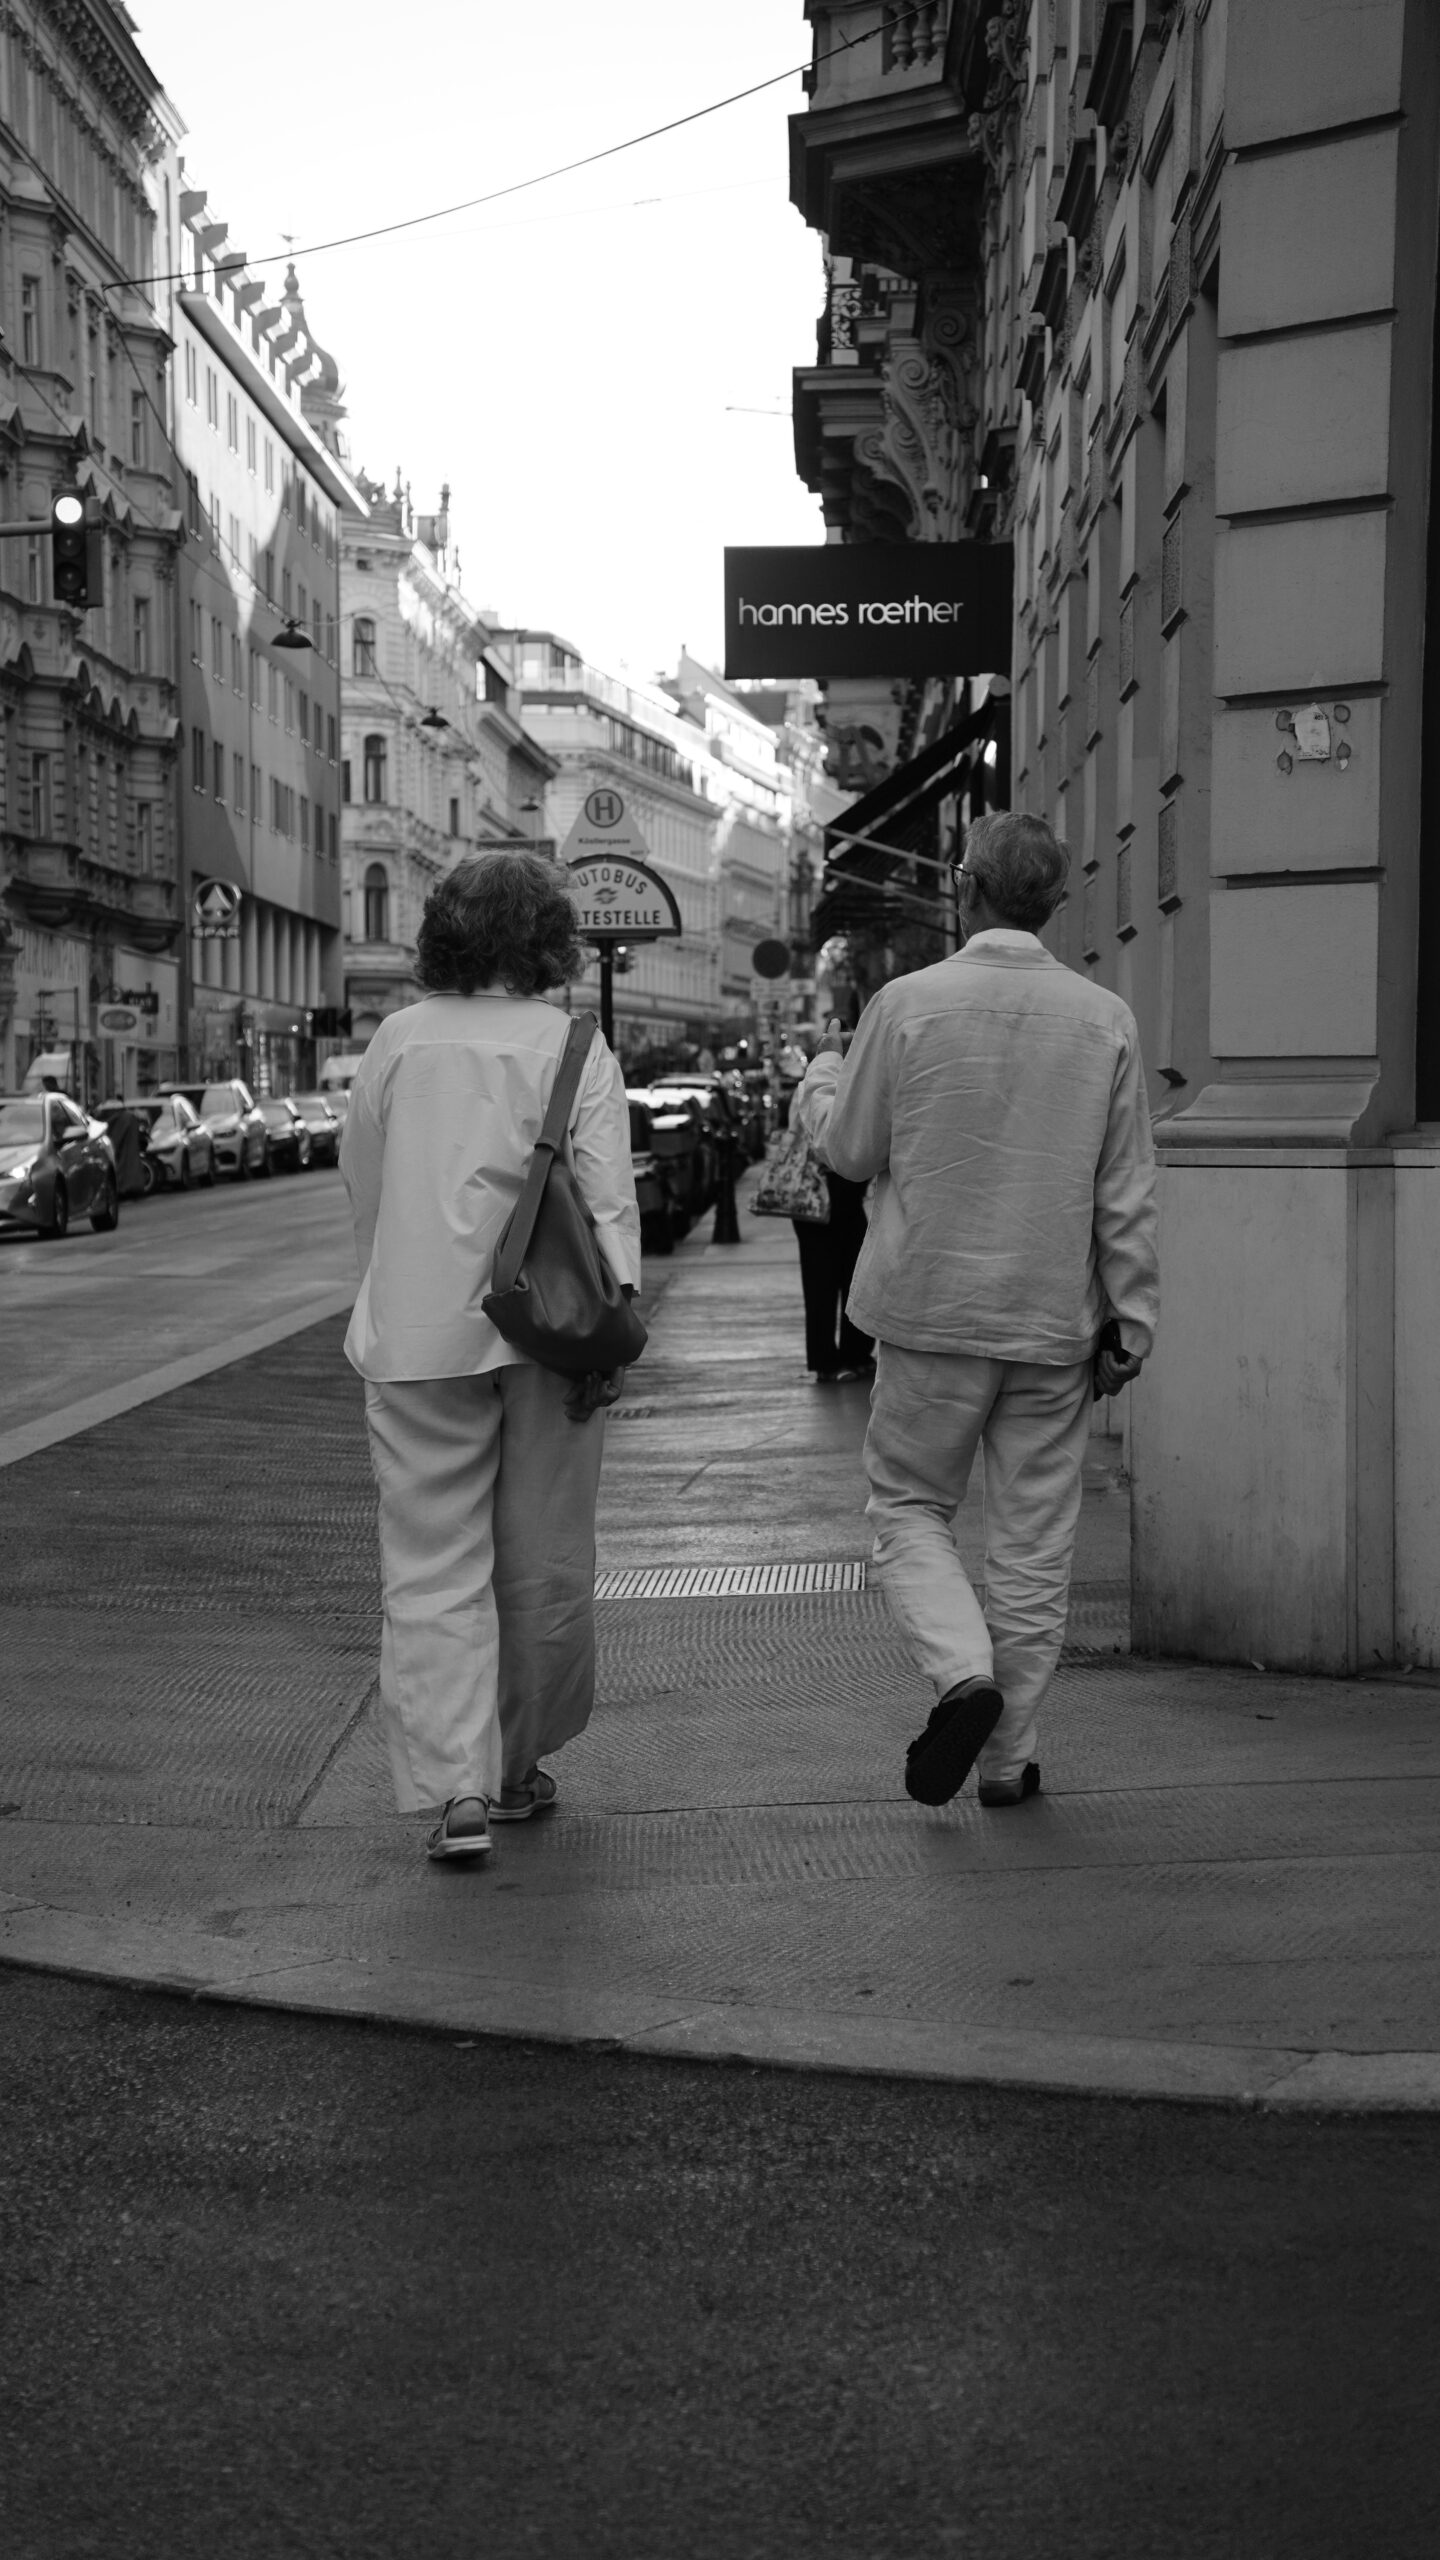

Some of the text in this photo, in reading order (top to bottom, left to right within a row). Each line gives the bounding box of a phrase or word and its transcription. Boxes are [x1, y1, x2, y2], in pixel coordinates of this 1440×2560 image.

[738, 597, 849, 626] hannes
[594, 796, 614, 821] H
[577, 867, 649, 895] UTOBUS
[578, 910, 661, 926] TESTELLE
[192, 925, 240, 939] SPAR
